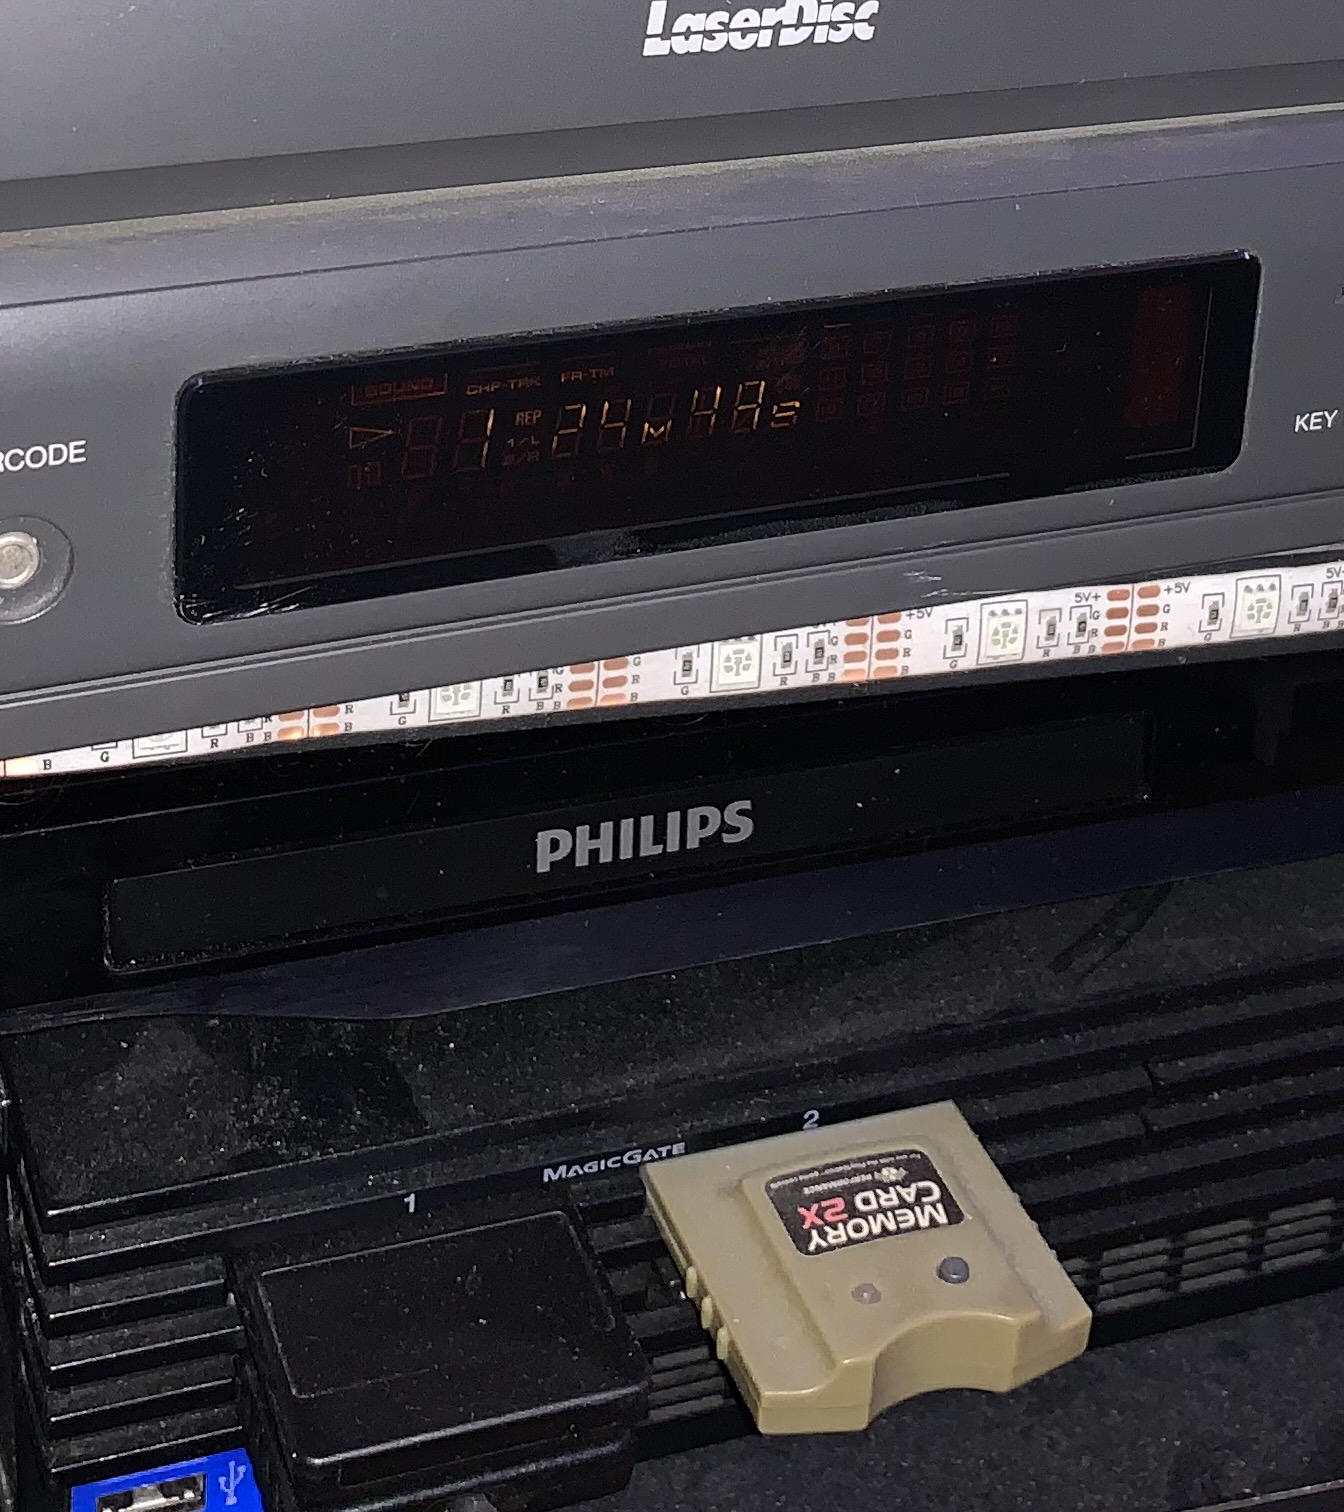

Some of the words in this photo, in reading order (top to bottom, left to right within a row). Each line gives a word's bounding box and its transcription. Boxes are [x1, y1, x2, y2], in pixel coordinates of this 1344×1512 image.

[1294, 407, 1338, 433] KEY
[1163, 581, 1191, 595] +5V
[1074, 591, 1102, 604] 5V+
[906, 606, 934, 620] +5V
[1162, 603, 1171, 614] G
[1160, 621, 1169, 632] R
[904, 629, 912, 640] G
[902, 647, 911, 658] R
[633, 656, 641, 667] G
[830, 654, 838, 665] R
[631, 674, 640, 685] R
[779, 676, 788, 687] R
[812, 673, 820, 683] B
[827, 671, 836, 682] B
[555, 683, 563, 693] R
[681, 685, 689, 696] G
[630, 692, 638, 702] B
[344, 704, 354, 715] R
[503, 705, 511, 715] R
[536, 701, 544, 711] B
[398, 716, 407, 726] G
[344, 722, 353, 733] B
[210, 736, 220, 749] R
[245, 731, 254, 743] B
[264, 731, 272, 743] B
[100, 751, 110, 763] G
[43, 759, 52, 772] B
[536, 800, 755, 873] PHILIPS
[803, 1109, 820, 1130] 2
[853, 1179, 942, 1213] CARD
[403, 1192, 416, 1213] 1
[797, 1196, 849, 1230] 2X
[807, 1203, 949, 1252] MEMORY
